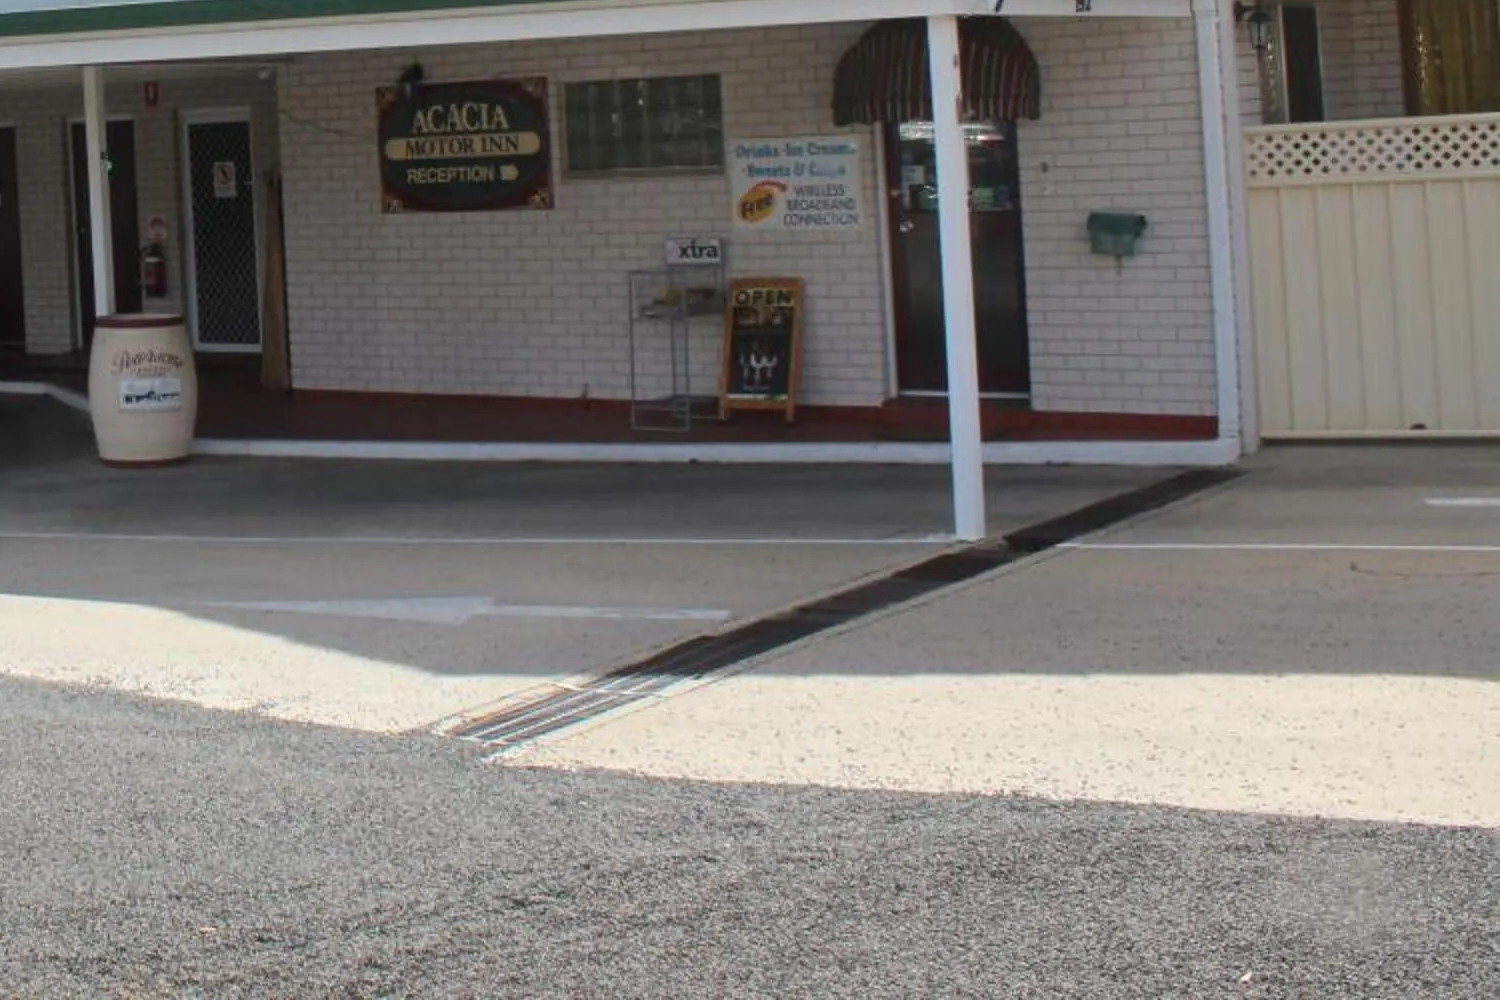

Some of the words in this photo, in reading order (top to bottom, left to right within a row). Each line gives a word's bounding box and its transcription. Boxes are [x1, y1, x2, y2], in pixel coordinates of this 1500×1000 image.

[411, 101, 510, 134] ACACIA
[405, 136, 475, 156] MOTOR
[481, 134, 519, 153] INN
[407, 165, 495, 184] RECEPTION
[793, 184, 845, 196] WIRELESS
[786, 198, 855, 211] BROADBAND
[783, 212, 860, 226] CONNECTION
[734, 290, 792, 305] OPEN
